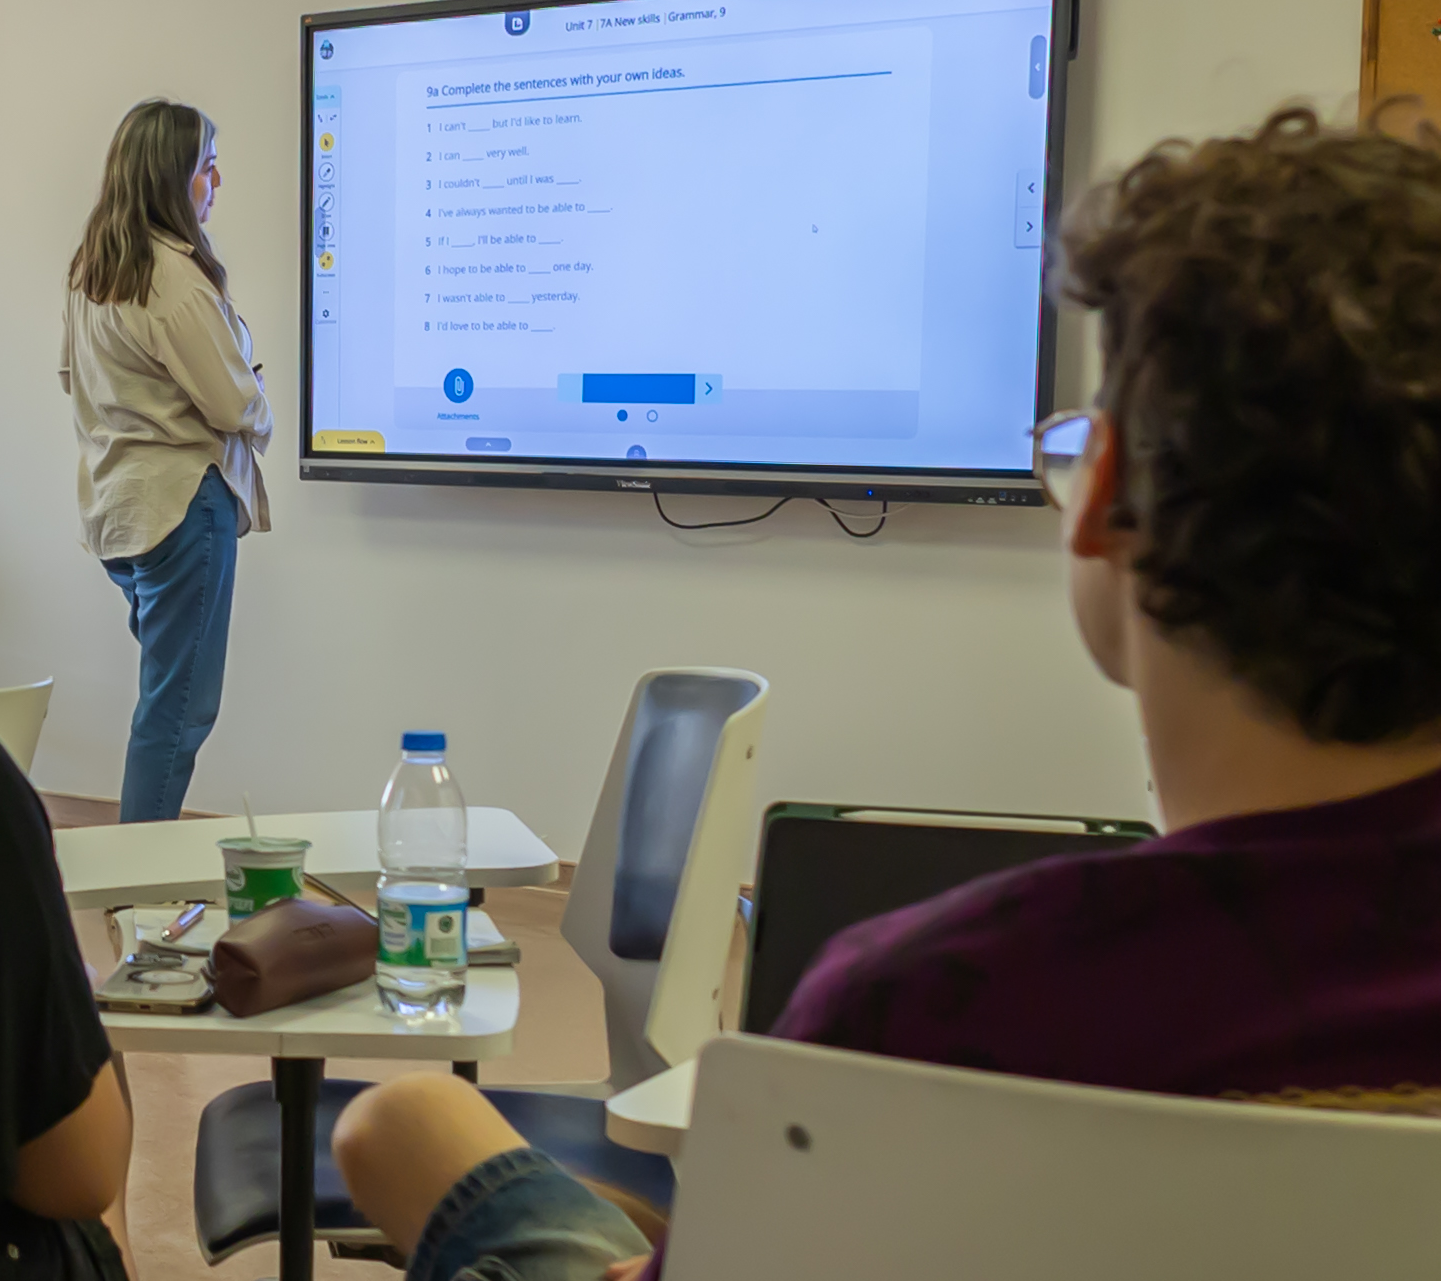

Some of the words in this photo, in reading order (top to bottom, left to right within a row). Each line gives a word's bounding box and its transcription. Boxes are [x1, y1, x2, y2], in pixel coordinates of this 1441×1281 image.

[566, 21, 585, 31] Unit
[615, 17, 636, 27] New
[638, 14, 660, 25] skills
[426, 87, 439, 98] 9a
[442, 83, 491, 97] Complete
[493, 82, 511, 93] the
[513, 77, 567, 91] sentences
[570, 74, 592, 86] with
[596, 72, 622, 87] your
[625, 70, 649, 82] own
[652, 67, 685, 79] ideas.
[444, 122, 466, 132] can't
[492, 118, 508, 128] but
[511, 118, 521, 127] I'd
[524, 116, 540, 126] like
[543, 116, 553, 125] to
[555, 114, 582, 124] learn.
[486, 150, 506, 160] very
[508, 146, 529, 157] well.
[444, 179, 480, 189] couldn't
[507, 175, 527, 185] until
[535, 175, 554, 184] was
[438, 209, 453, 217] I've
[456, 207, 486, 218] always
[488, 205, 523, 215] wanted
[525, 205, 535, 214] to
[537, 204, 549, 213] be
[552, 203, 572, 213] able
[575, 203, 585, 211] to
[438, 237, 444, 246] If
[490, 236, 502, 244] be
[504, 234, 524, 244] able
[526, 234, 536, 243] to
[443, 266, 466, 276] hope
[468, 265, 478, 274] to
[480, 264, 491, 273] be
[494, 264, 514, 273] able
[516, 264, 526, 272] to
[553, 263, 571, 271] one
[574, 261, 593, 273] day.
[442, 294, 472, 302] wasn't
[474, 293, 493, 302] able
[495, 294, 505, 302] to
[531, 292, 580, 304] yesterday.
[437, 322, 448, 330] I'd
[450, 321, 468, 330] love
[471, 322, 480, 330] to
[483, 321, 494, 330] be
[497, 321, 516, 330] able
[519, 322, 528, 330] to
